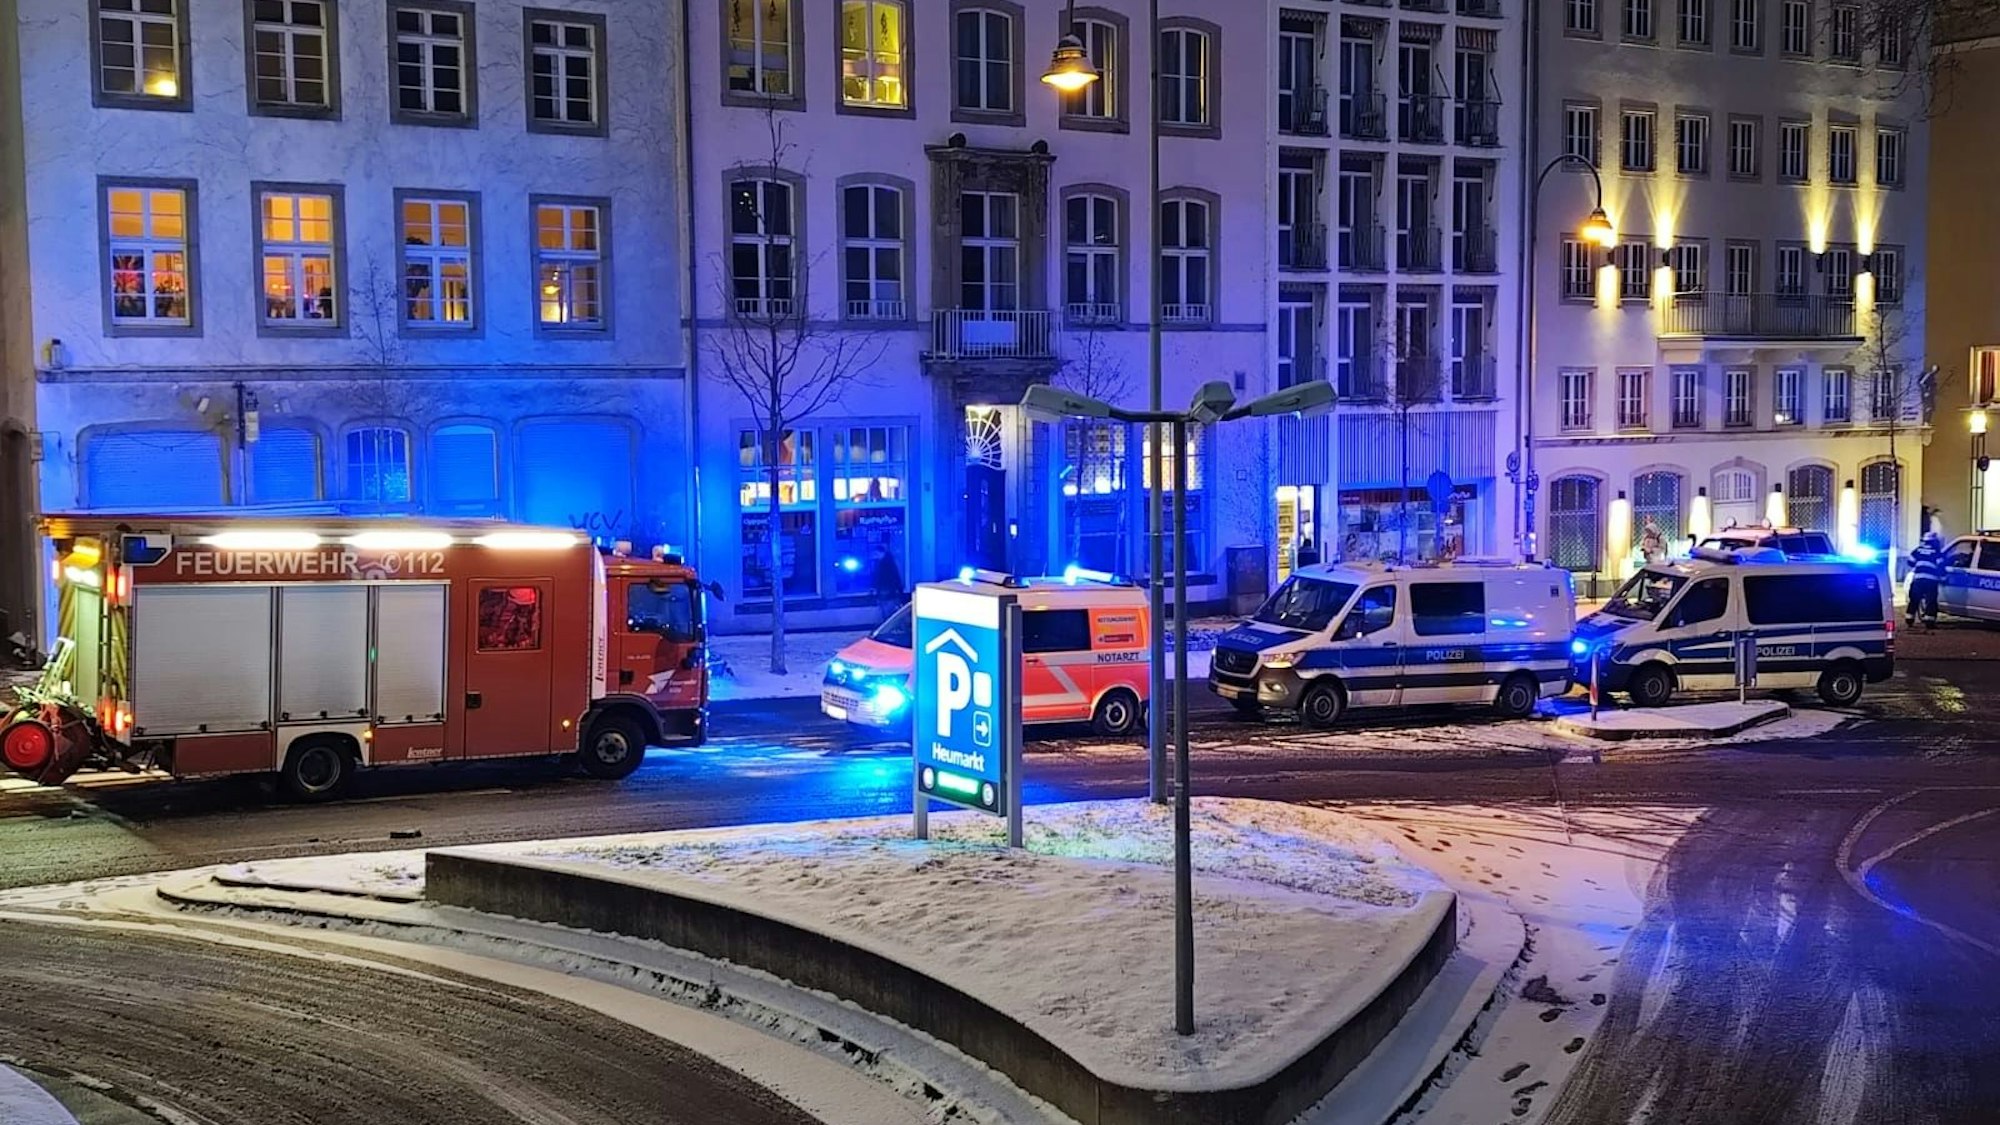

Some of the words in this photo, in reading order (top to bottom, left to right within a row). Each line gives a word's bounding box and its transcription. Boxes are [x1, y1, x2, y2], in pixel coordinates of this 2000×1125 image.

[176, 551, 359, 575] FEUERWEHR
[404, 552, 445, 573] 112
[1098, 652, 1139, 663] NOTARZT
[1426, 650, 1465, 660] POLIZEI
[1756, 646, 1795, 657] POLIZEI
[936, 651, 972, 738] P
[932, 742, 985, 772] Heumarkt
